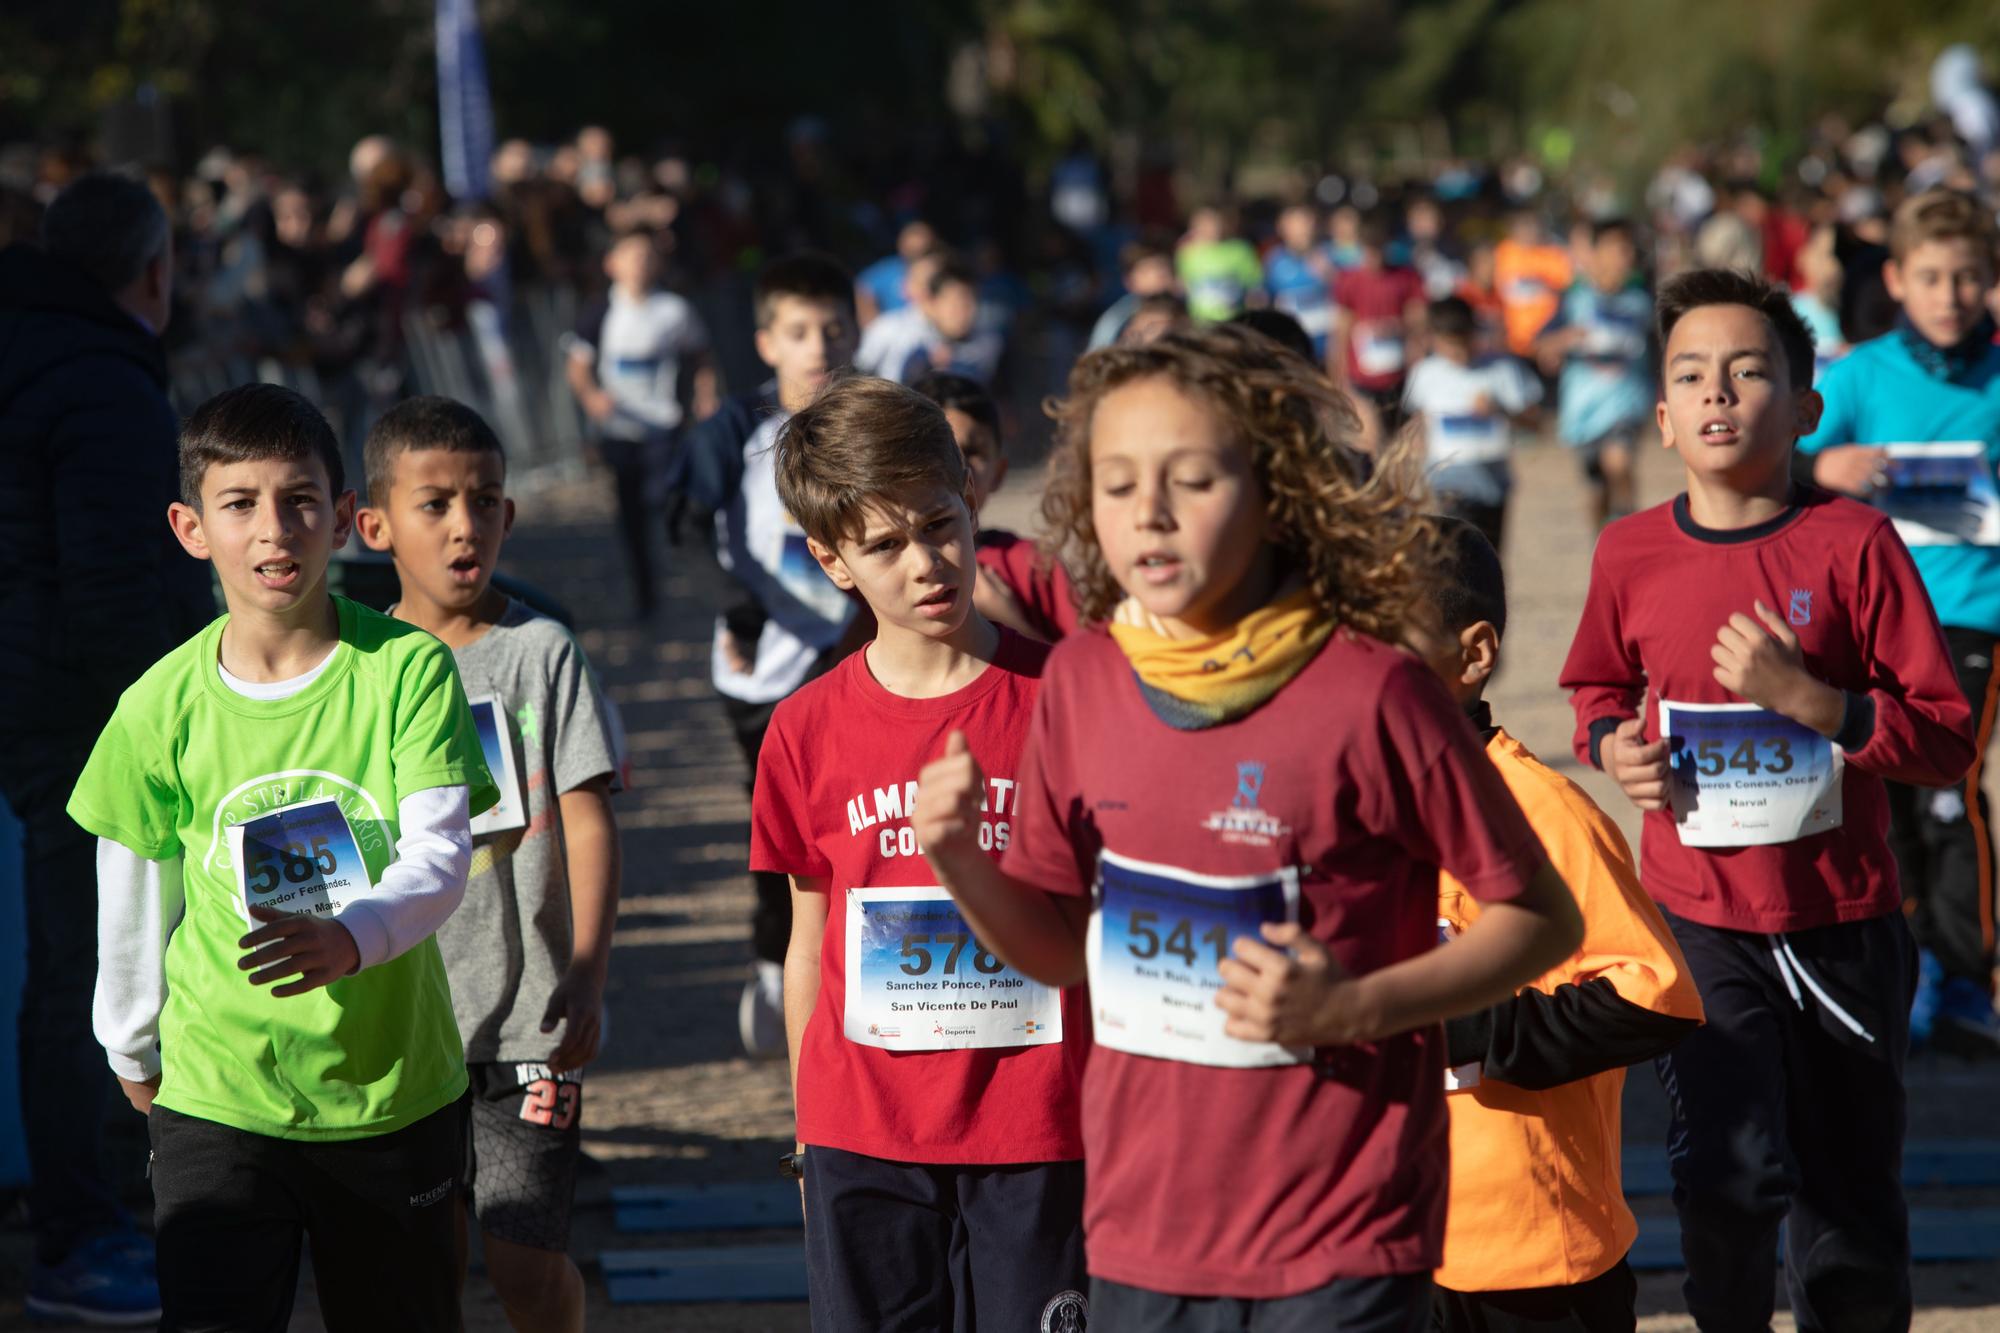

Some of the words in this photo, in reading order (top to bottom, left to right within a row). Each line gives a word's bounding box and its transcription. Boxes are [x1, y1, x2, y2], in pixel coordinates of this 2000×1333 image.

[1697, 737, 1794, 776] 543
[1735, 779, 1781, 790] Conesa,
[1785, 775, 1818, 786] Oscar
[1730, 798, 1767, 808] Narval
[336, 790, 383, 852] MARIS
[247, 836, 337, 895] 585
[299, 878, 351, 897] Fernandez,
[315, 899, 341, 913] Maris
[1127, 909, 1229, 967] 541
[900, 933, 1006, 976] 578
[886, 980, 938, 991] Sanchez
[942, 979, 986, 991] Ponce,
[989, 978, 1024, 989] Pablo
[891, 1001, 913, 1012] San
[917, 1000, 966, 1012] Vicente
[970, 1000, 987, 1011] De
[992, 999, 1019, 1010] Paul
[519, 1079, 580, 1130] 23
